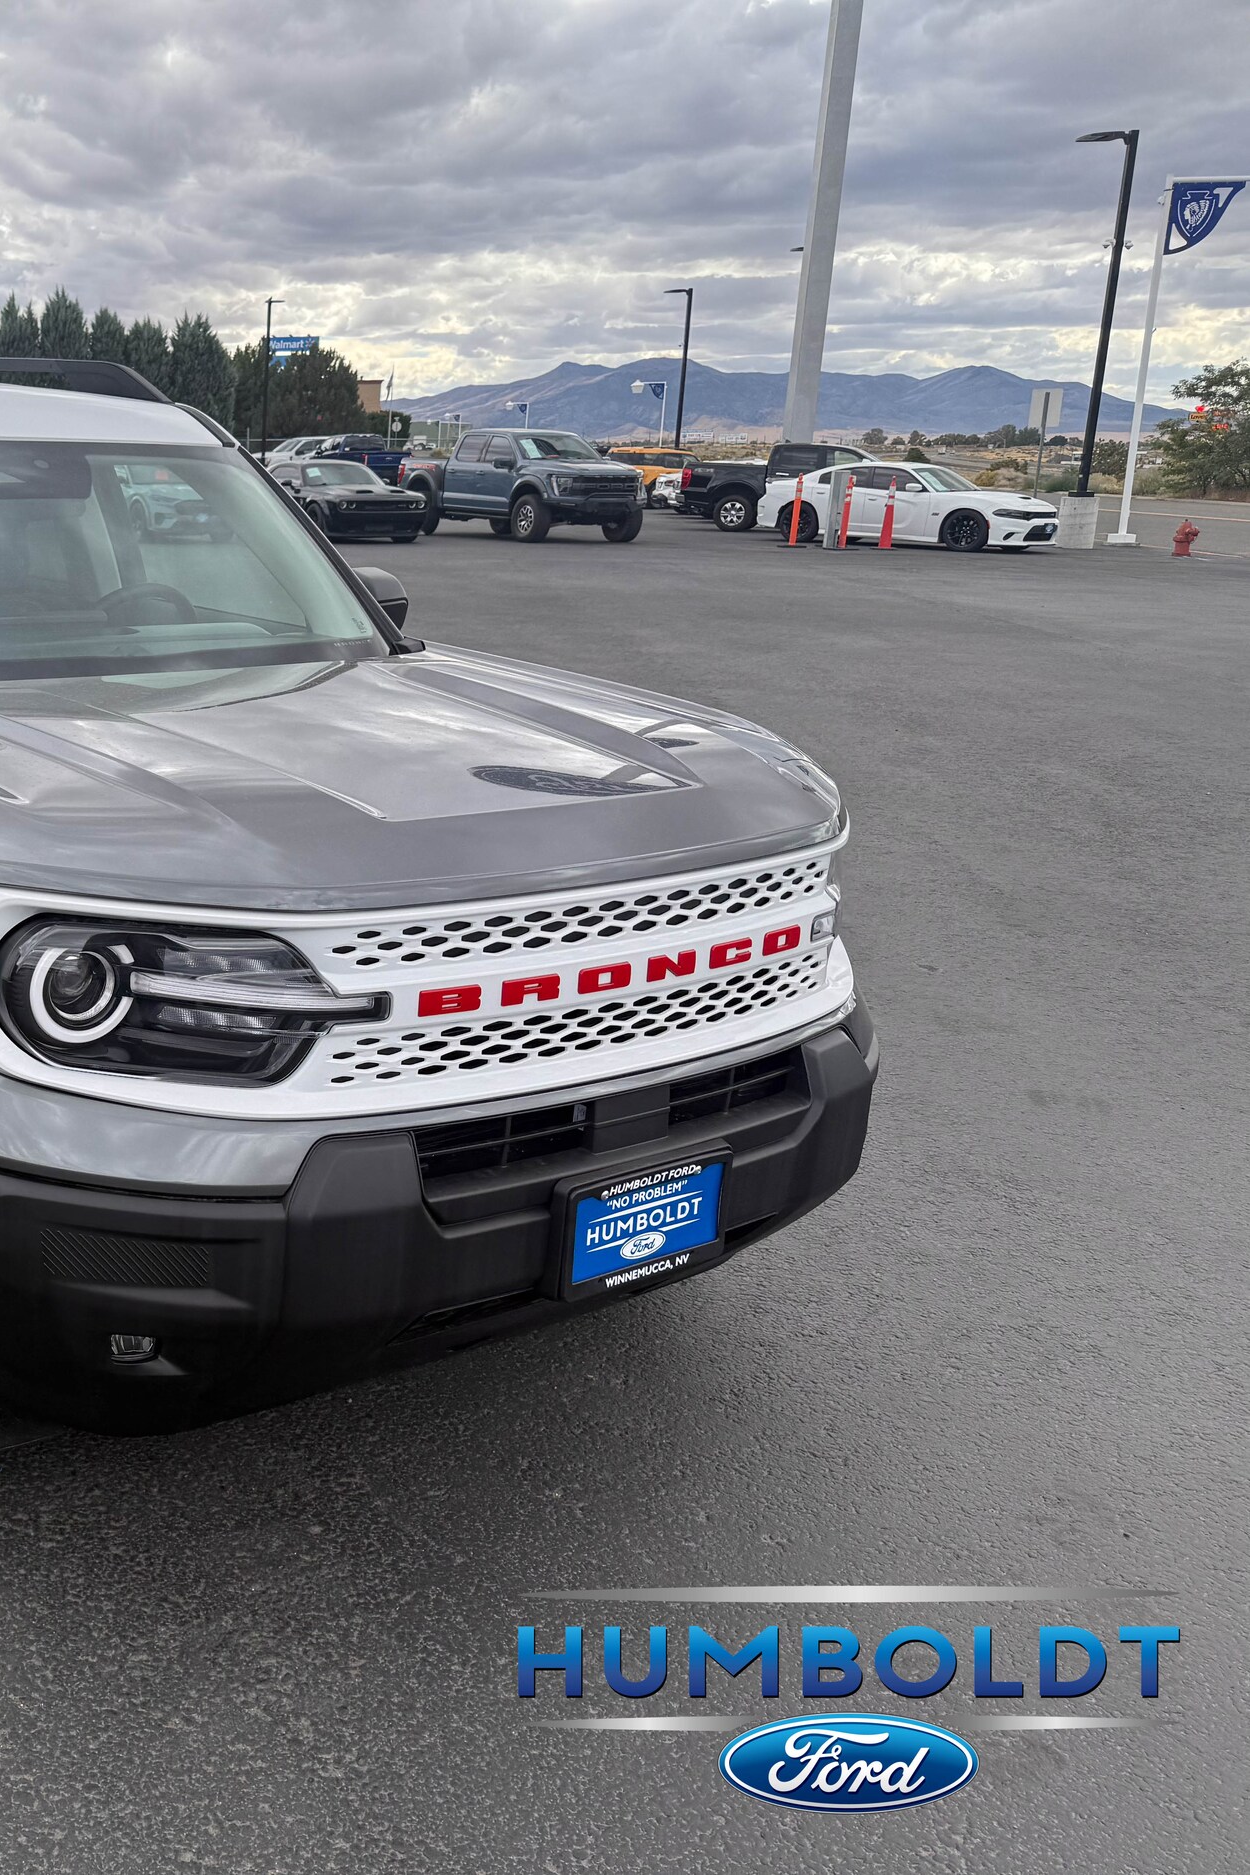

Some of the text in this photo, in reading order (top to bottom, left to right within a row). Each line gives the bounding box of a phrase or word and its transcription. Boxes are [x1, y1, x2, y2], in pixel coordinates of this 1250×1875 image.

[417, 925, 801, 1017] BRONCO
[609, 1164, 696, 1196] HUMBOLDT FORD
[586, 1197, 702, 1246] HUMBOLDT
[630, 1236, 656, 1255] Ford
[605, 1253, 690, 1288] WINNEMUCCA, NV
